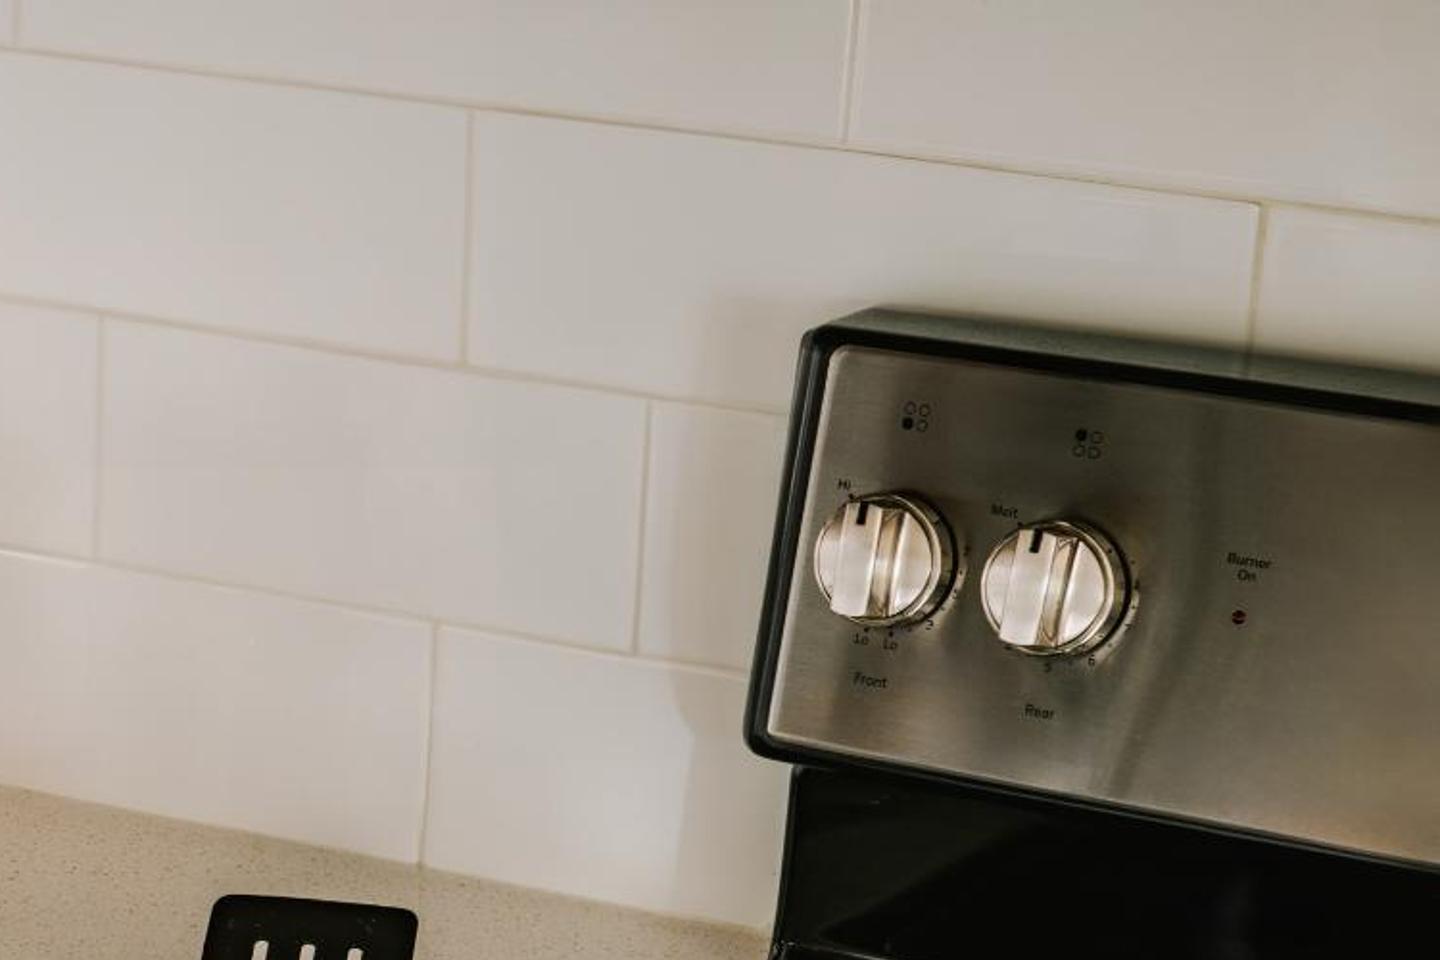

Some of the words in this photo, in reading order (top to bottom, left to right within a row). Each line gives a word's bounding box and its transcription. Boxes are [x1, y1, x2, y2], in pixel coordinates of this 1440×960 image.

[1237, 569, 1257, 581] On
[853, 672, 888, 688] Front
[1024, 704, 1055, 719] Rear
